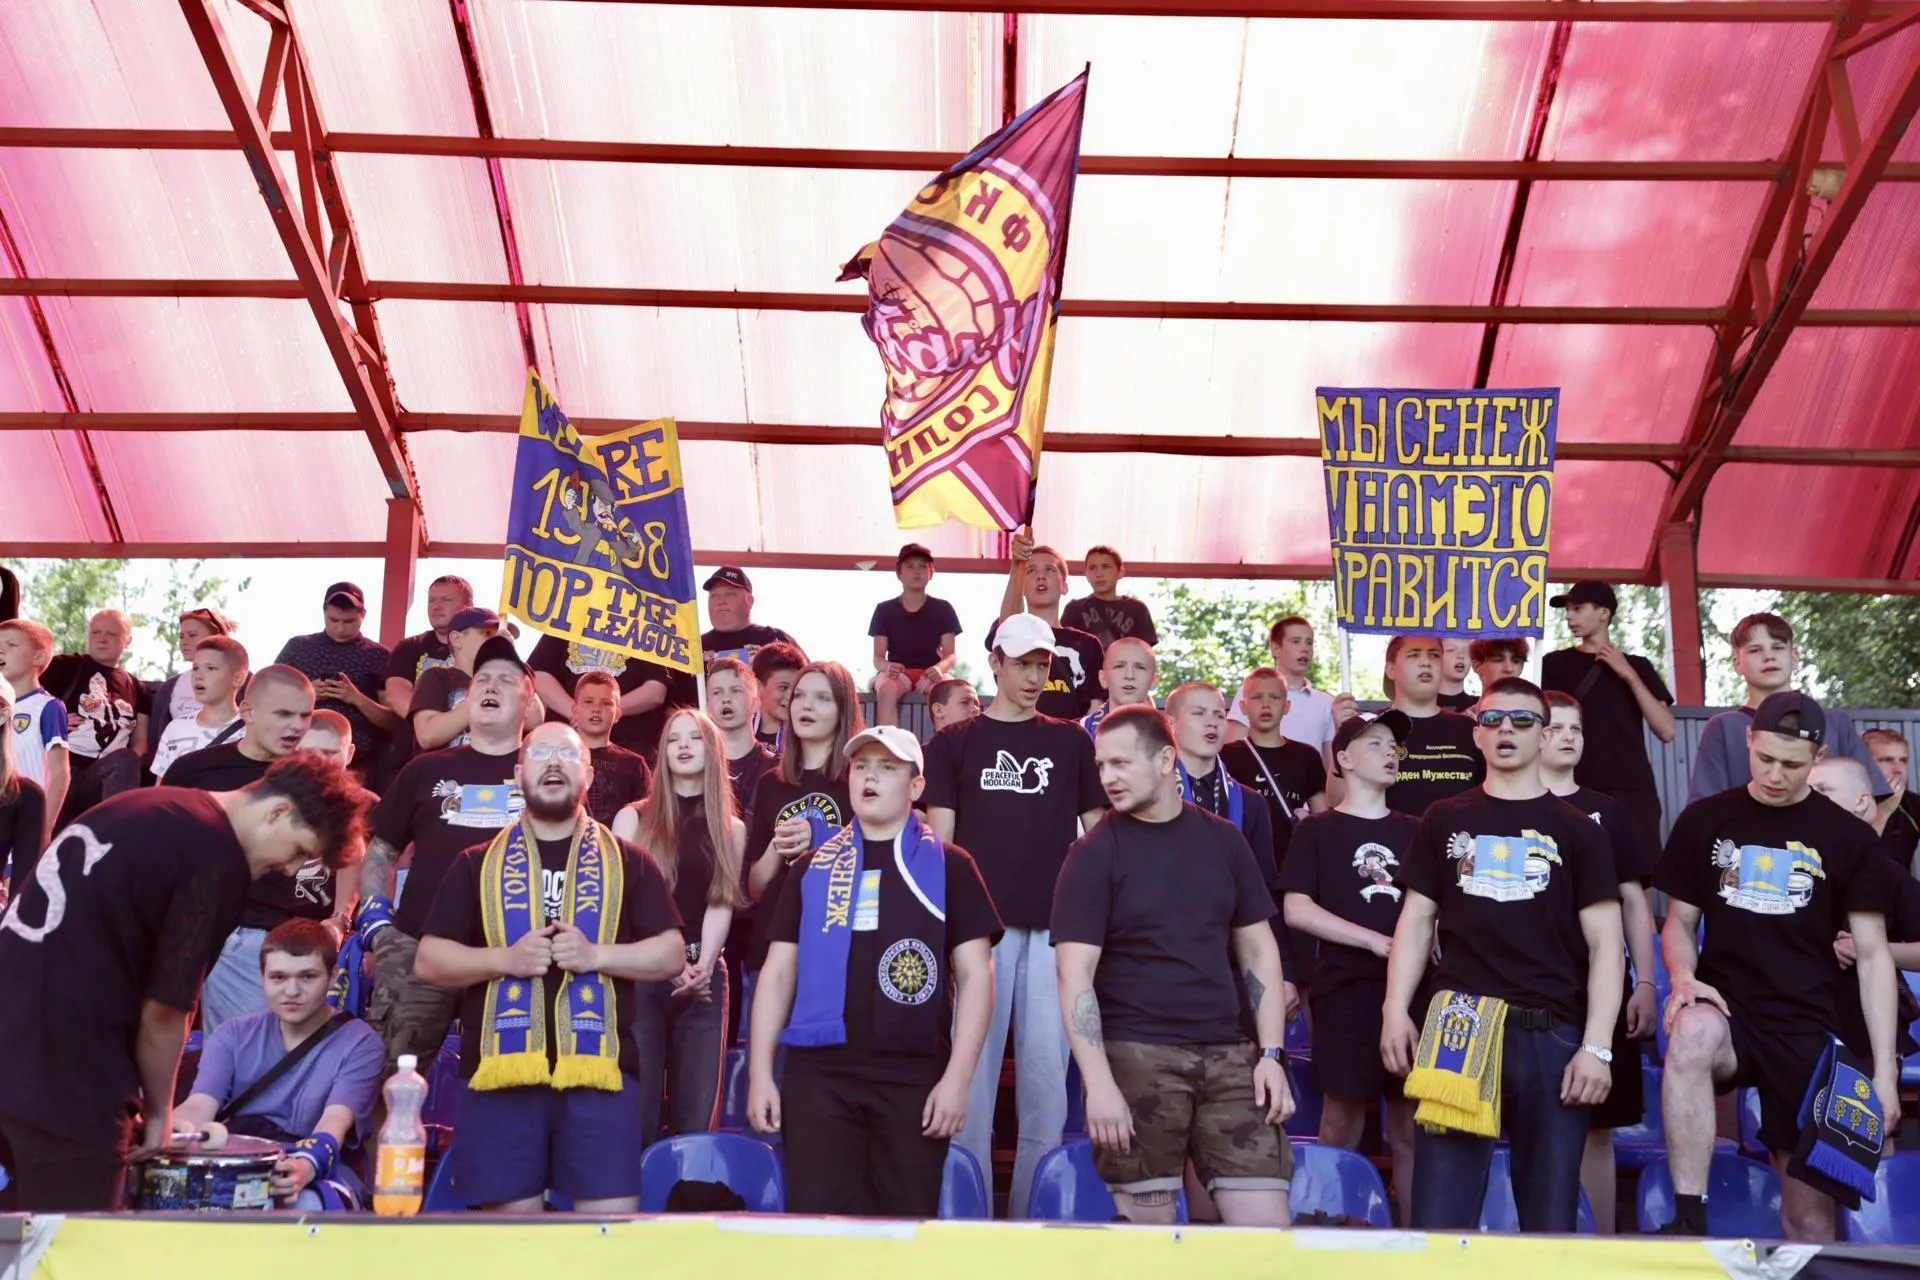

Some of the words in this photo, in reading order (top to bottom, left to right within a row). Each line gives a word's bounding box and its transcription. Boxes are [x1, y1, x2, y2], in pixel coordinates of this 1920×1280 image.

[1317, 396, 1387, 463] МЫ
[1395, 397, 1553, 467] СЕНЕЖ
[1353, 471, 1457, 546] НАМ
[1460, 475, 1551, 549] ЭТО
[507, 548, 593, 632] TOP
[605, 576, 677, 635] THE
[582, 607, 690, 665] LEAGUE
[983, 779, 1021, 788] HOOLIGAN
[985, 771, 1020, 781] PEACEFUL
